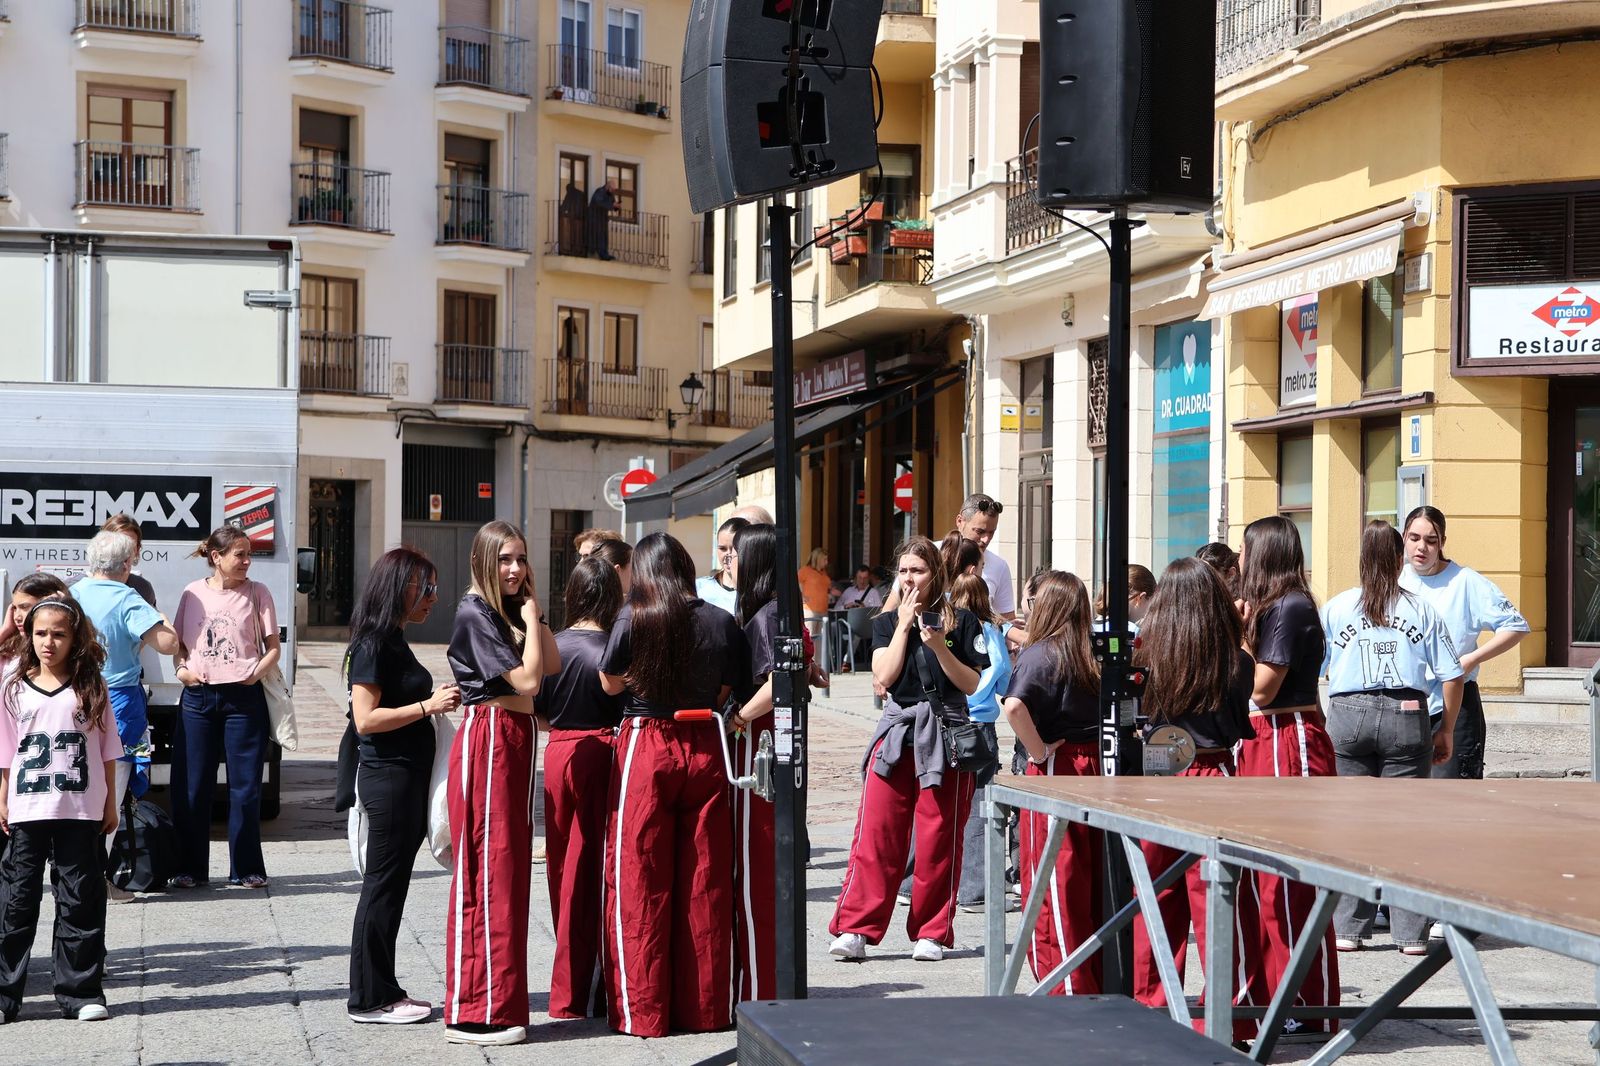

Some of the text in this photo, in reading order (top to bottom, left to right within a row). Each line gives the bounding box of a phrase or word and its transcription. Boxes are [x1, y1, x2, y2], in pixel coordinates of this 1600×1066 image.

[1232, 271, 1304, 311] RESTAURANTE
[1306, 261, 1342, 291] METRO
[1344, 245, 1392, 279] ZAMORA
[1554, 306, 1588, 318] metro
[1499, 337, 1600, 354] Restaura
[1285, 370, 1306, 393] metro
[1161, 399, 1174, 419] DR.
[0, 488, 200, 529] RE3MAX
[1334, 624, 1358, 649] LOS
[1374, 641, 1398, 654] 1987
[794, 710, 802, 788] GUIL
[1103, 705, 1116, 776] GUIL
[16, 730, 89, 796] 23
